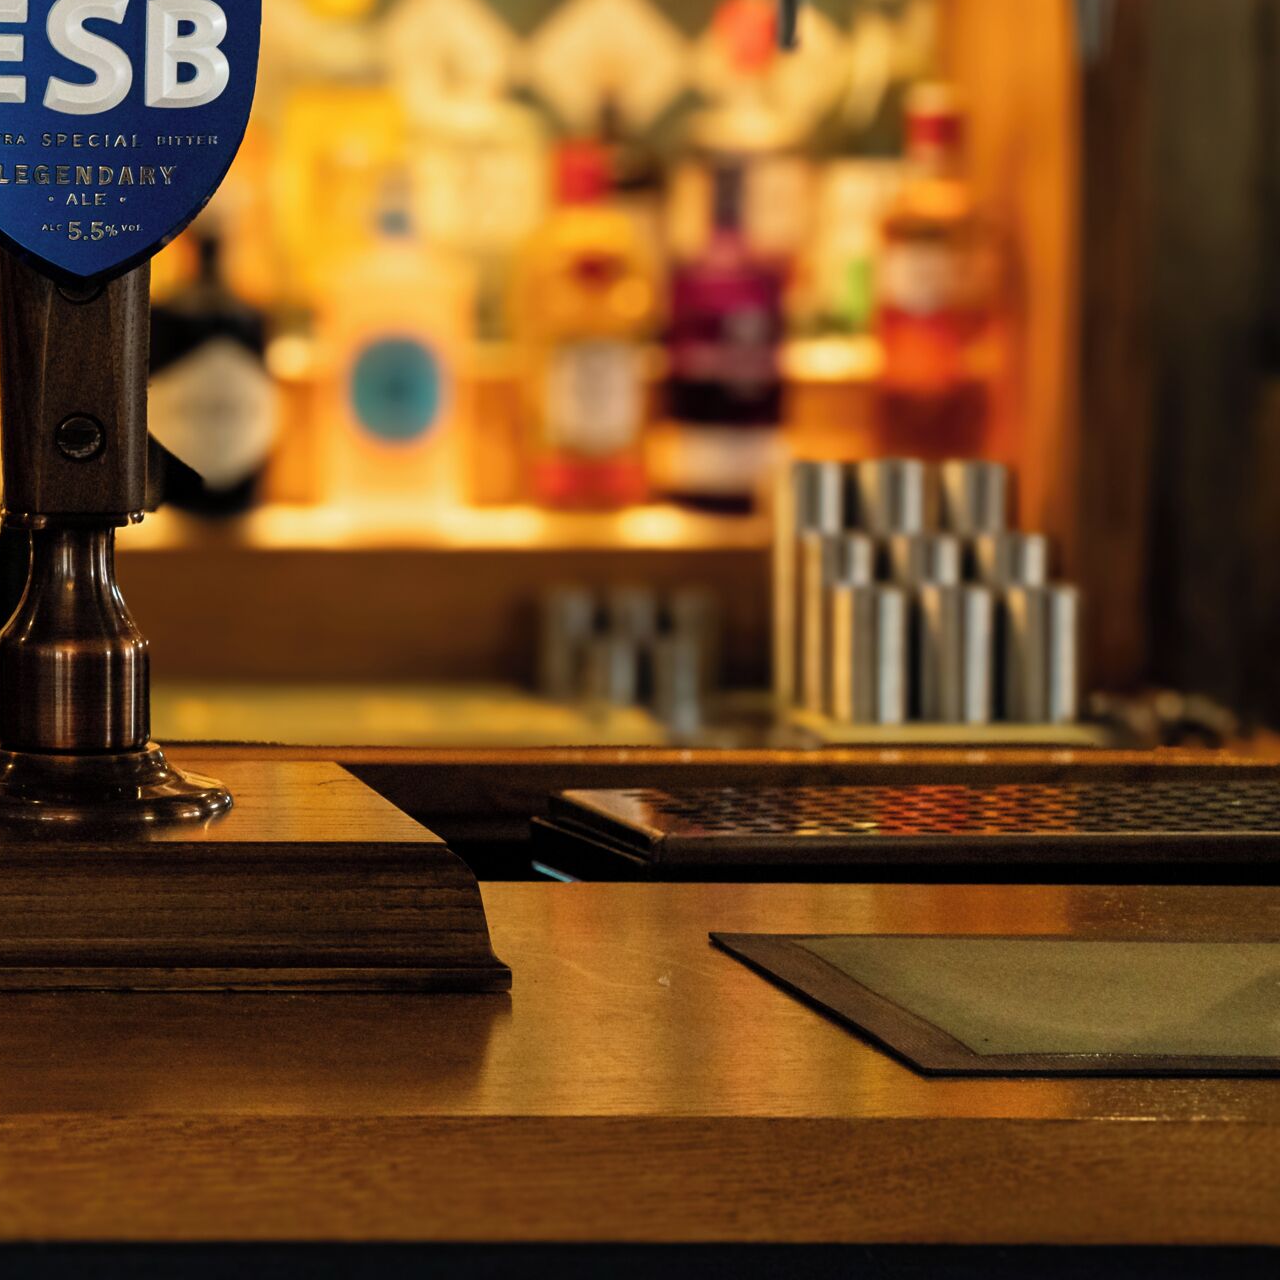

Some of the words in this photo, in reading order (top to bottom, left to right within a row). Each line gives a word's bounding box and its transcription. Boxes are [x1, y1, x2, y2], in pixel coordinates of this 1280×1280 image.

[41, 132, 143, 147] SPECIAL
[156, 134, 219, 146] BITTER
[65, 192, 108, 206] ALE
[41, 223, 63, 232] ALC
[67, 219, 119, 242] 5.5%
